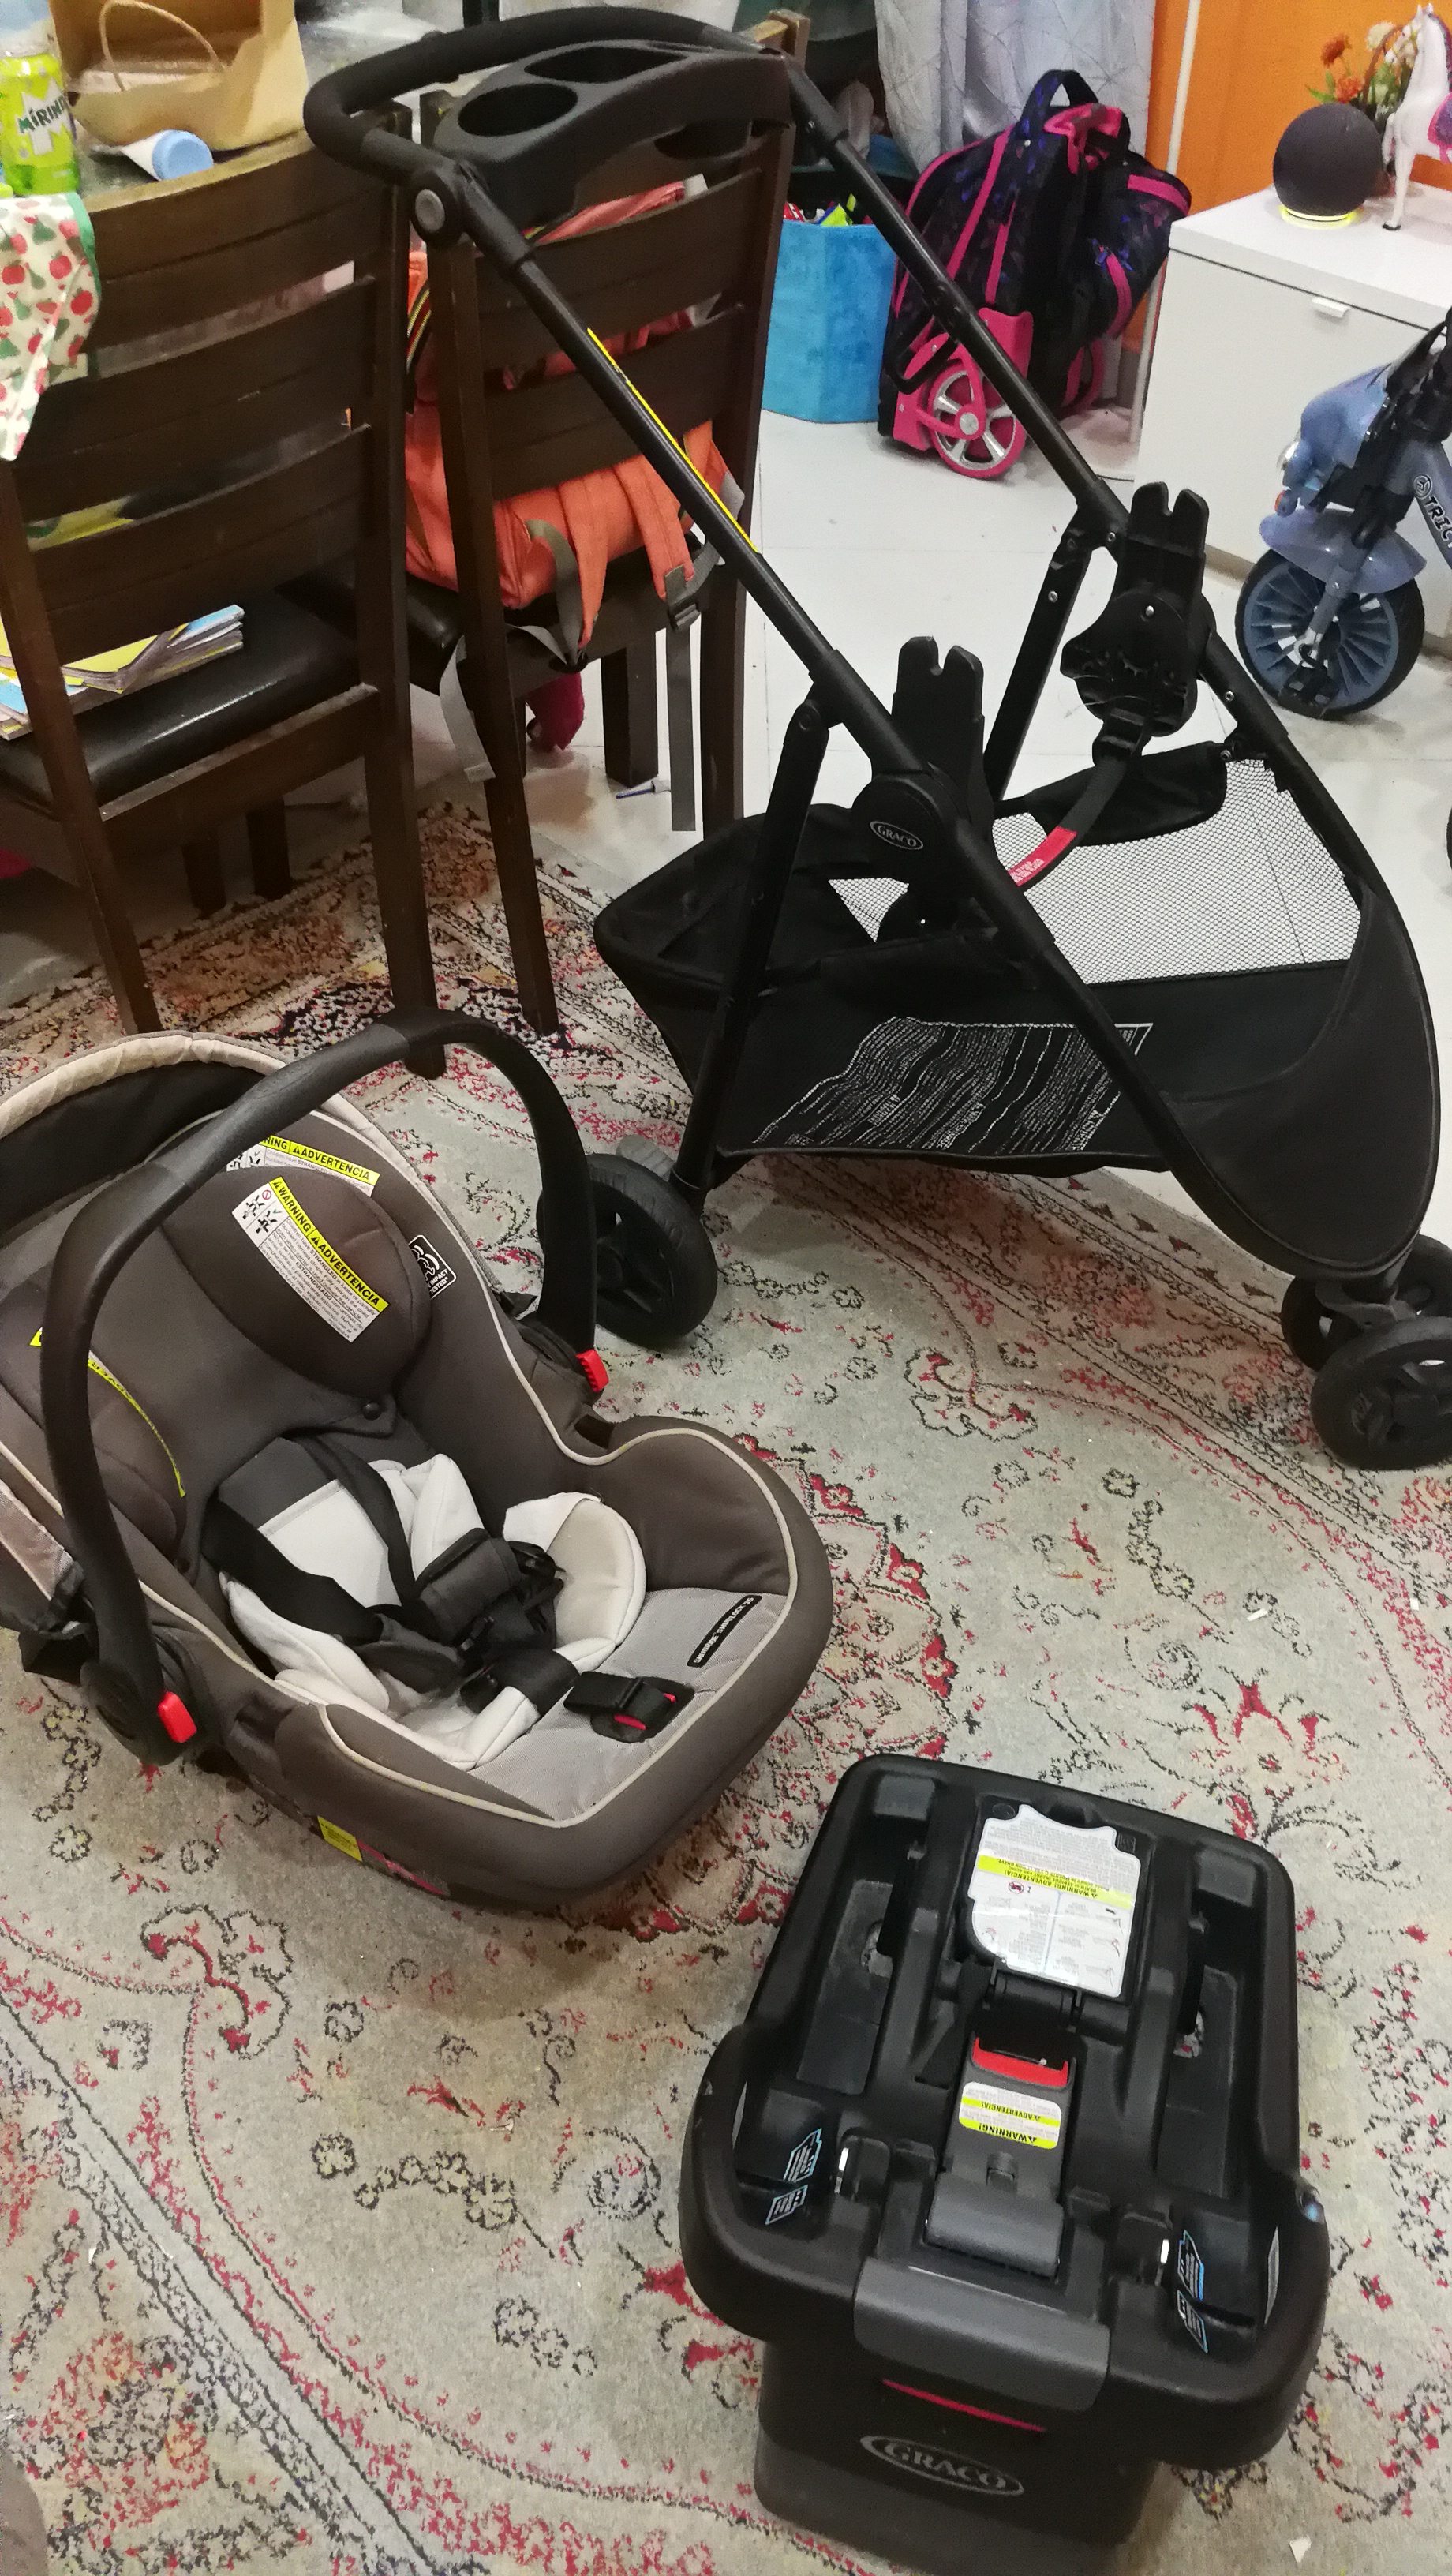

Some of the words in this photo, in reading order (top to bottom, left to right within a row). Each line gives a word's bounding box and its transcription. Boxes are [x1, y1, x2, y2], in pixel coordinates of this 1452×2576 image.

[1423, 496, 1452, 549] TRIC
[877, 825, 918, 848] GRACO
[264, 1136, 288, 1150] NING
[300, 1148, 371, 1180] ADVERTENCIA
[276, 1185, 312, 1233] WARNING
[317, 1241, 381, 1306] ADVERTENCIA
[429, 1268, 449, 1286] IMPACT
[980, 2101, 1033, 2119] ADVERTENCIA!
[978, 2122, 1027, 2142] WARNING!
[882, 2440, 1009, 2492] GRACO
